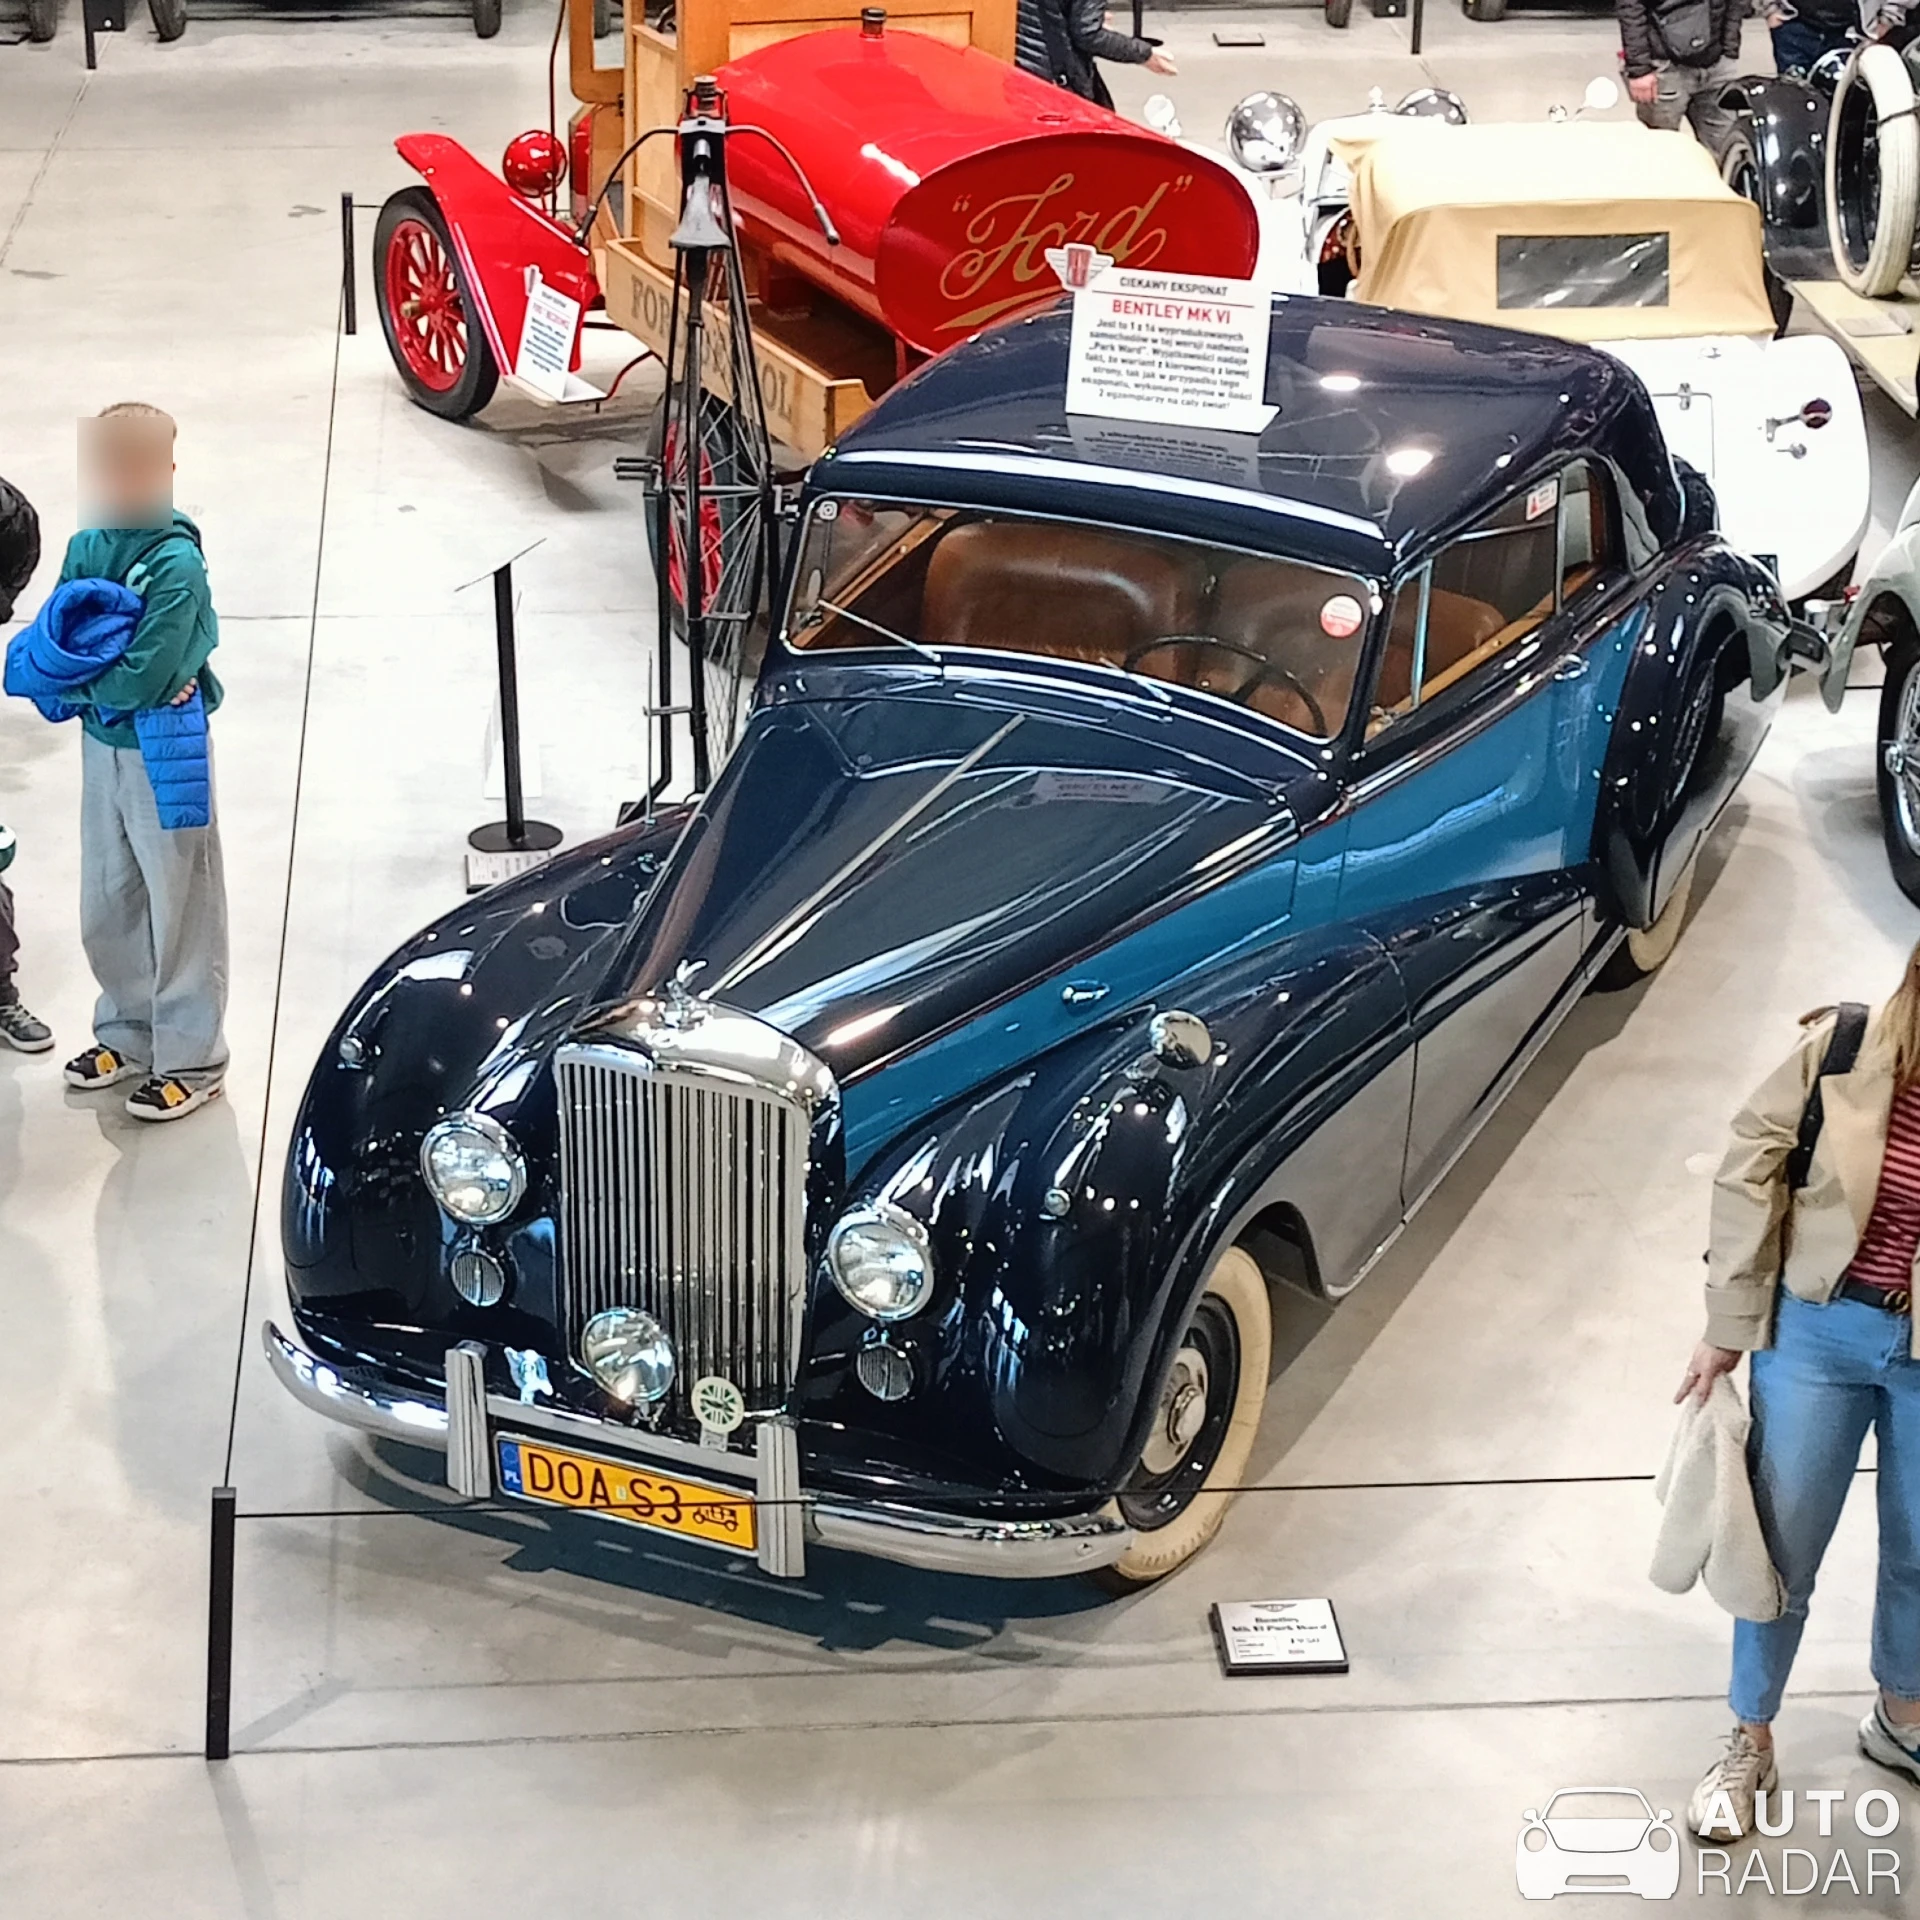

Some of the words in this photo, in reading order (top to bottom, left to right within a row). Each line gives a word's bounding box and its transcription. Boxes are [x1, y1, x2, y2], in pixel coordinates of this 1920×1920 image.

[1120, 276, 1168, 291] CIEKAWY
[1171, 282, 1228, 296] EKSPONAT
[1112, 299, 1182, 319] BENTLEY
[1187, 308, 1212, 322] MK
[1217, 310, 1231, 324] VI
[1097, 318, 1116, 328] Jest
[1119, 321, 1127, 329] to
[504, 1469, 521, 1484] PL
[528, 1452, 612, 1508] DOA
[629, 1478, 682, 1525] S3
